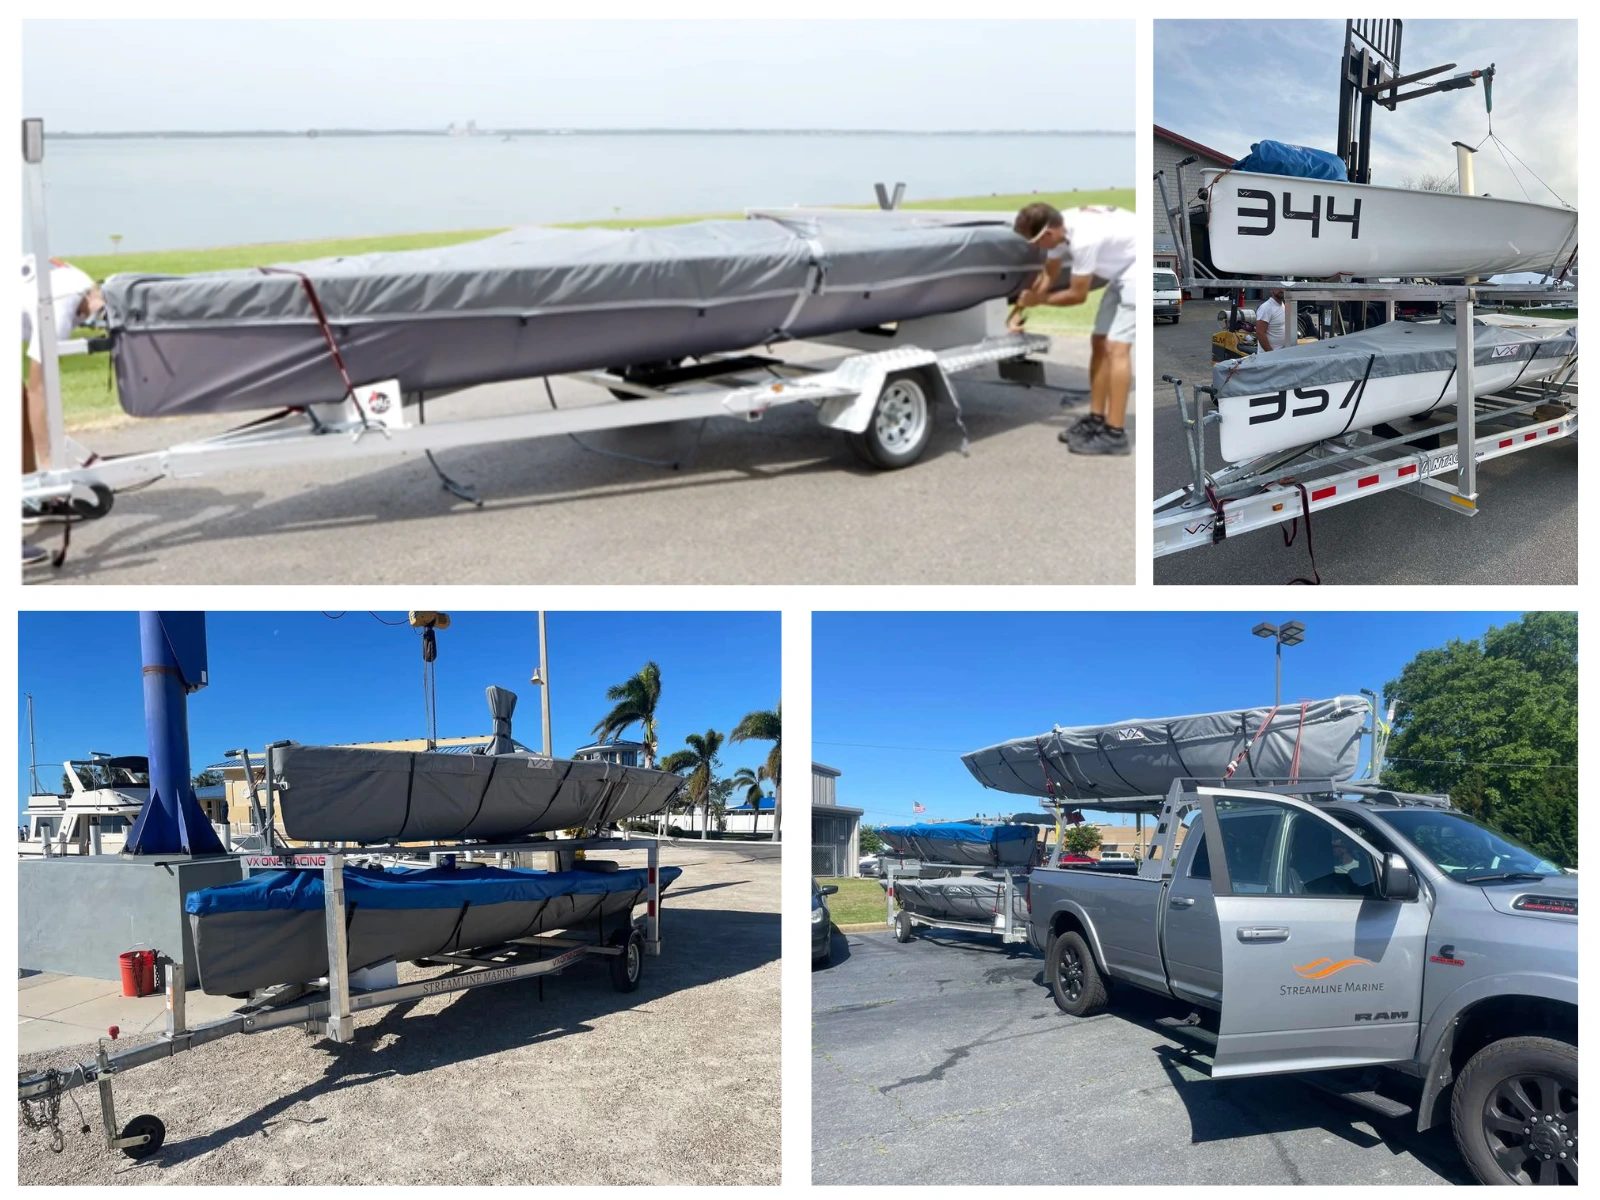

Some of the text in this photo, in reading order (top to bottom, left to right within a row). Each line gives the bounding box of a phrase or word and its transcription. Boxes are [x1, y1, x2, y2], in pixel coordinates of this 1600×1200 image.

[1238, 188, 1362, 239] 344
[246, 856, 326, 867] VX ONE RACING
[423, 967, 518, 994] STREAMLINE MARINE
[1354, 1011, 1409, 1021] RAM
